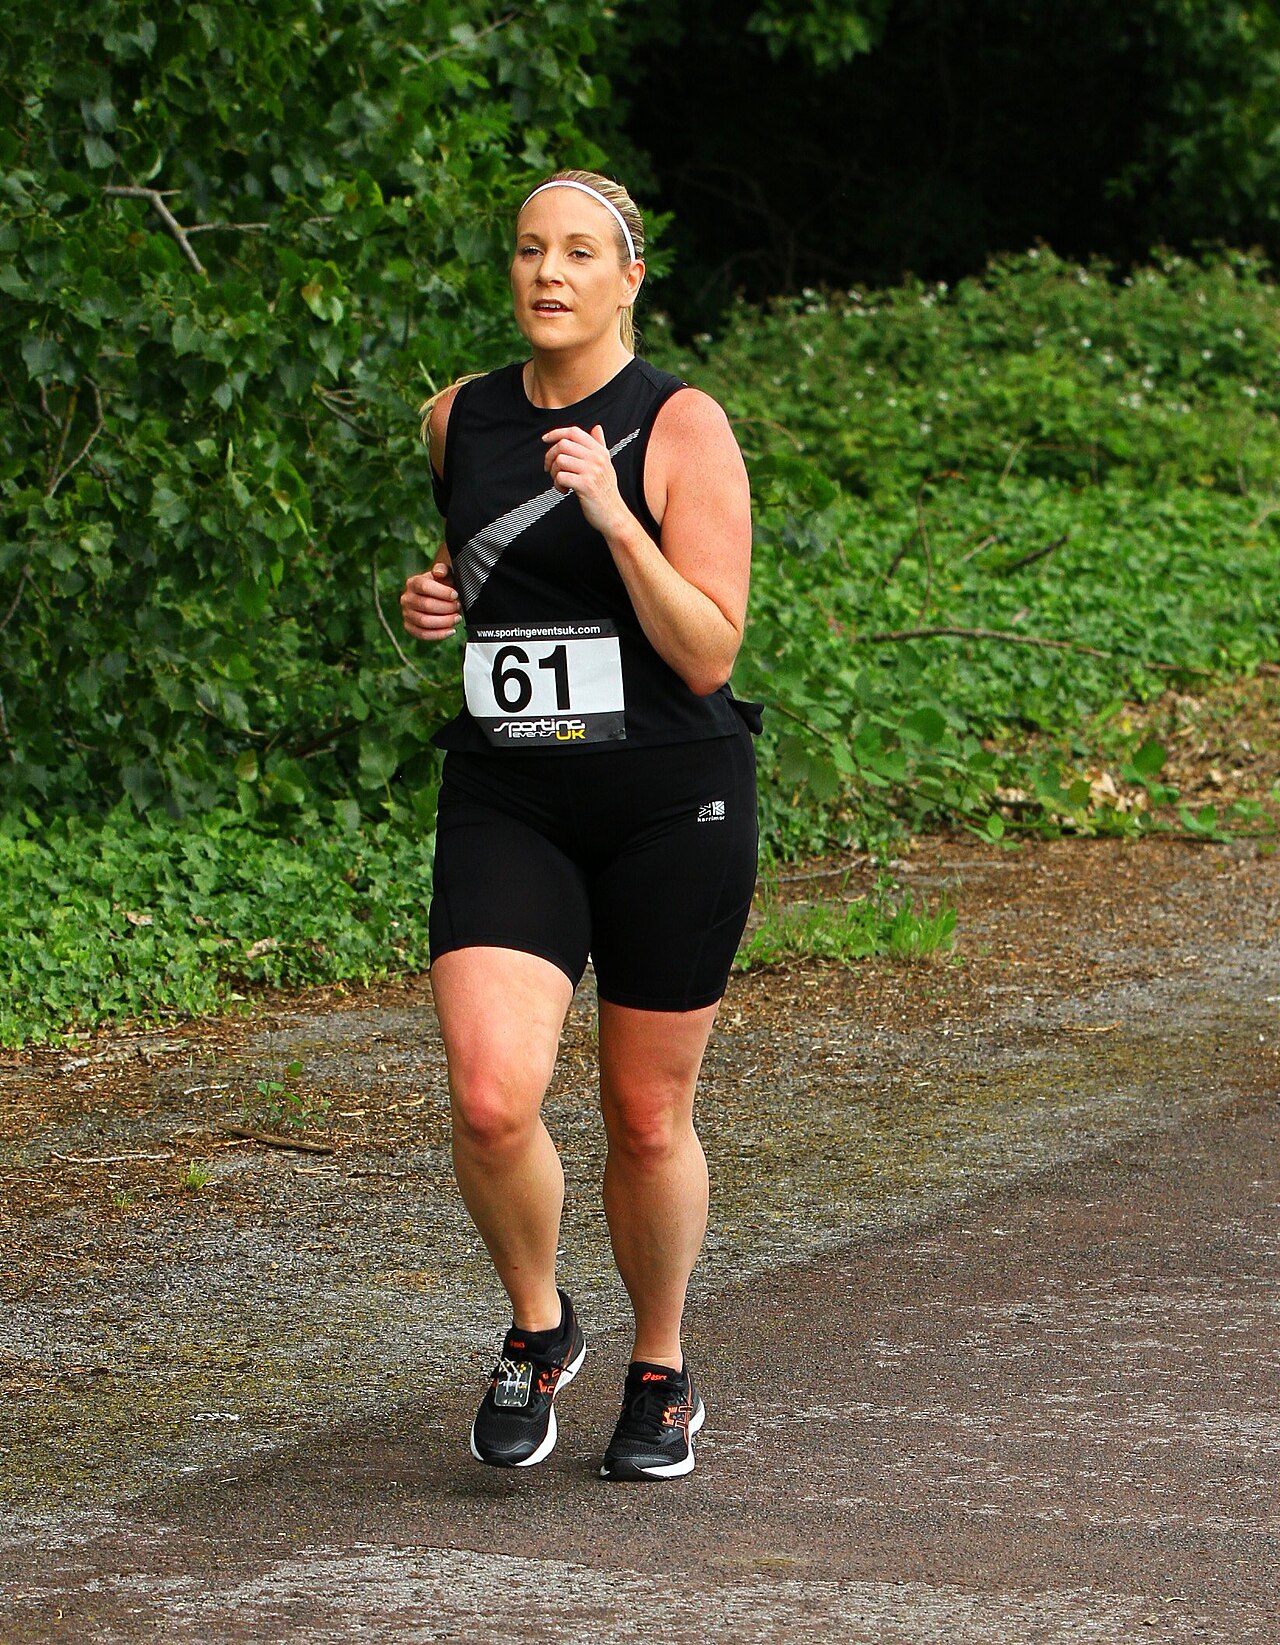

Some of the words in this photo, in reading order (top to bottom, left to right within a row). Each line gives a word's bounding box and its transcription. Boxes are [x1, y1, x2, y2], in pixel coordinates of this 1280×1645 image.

[477, 625, 600, 639] www.sportingeventsuk.com
[492, 645, 570, 713] 61
[556, 730, 586, 740] UK
